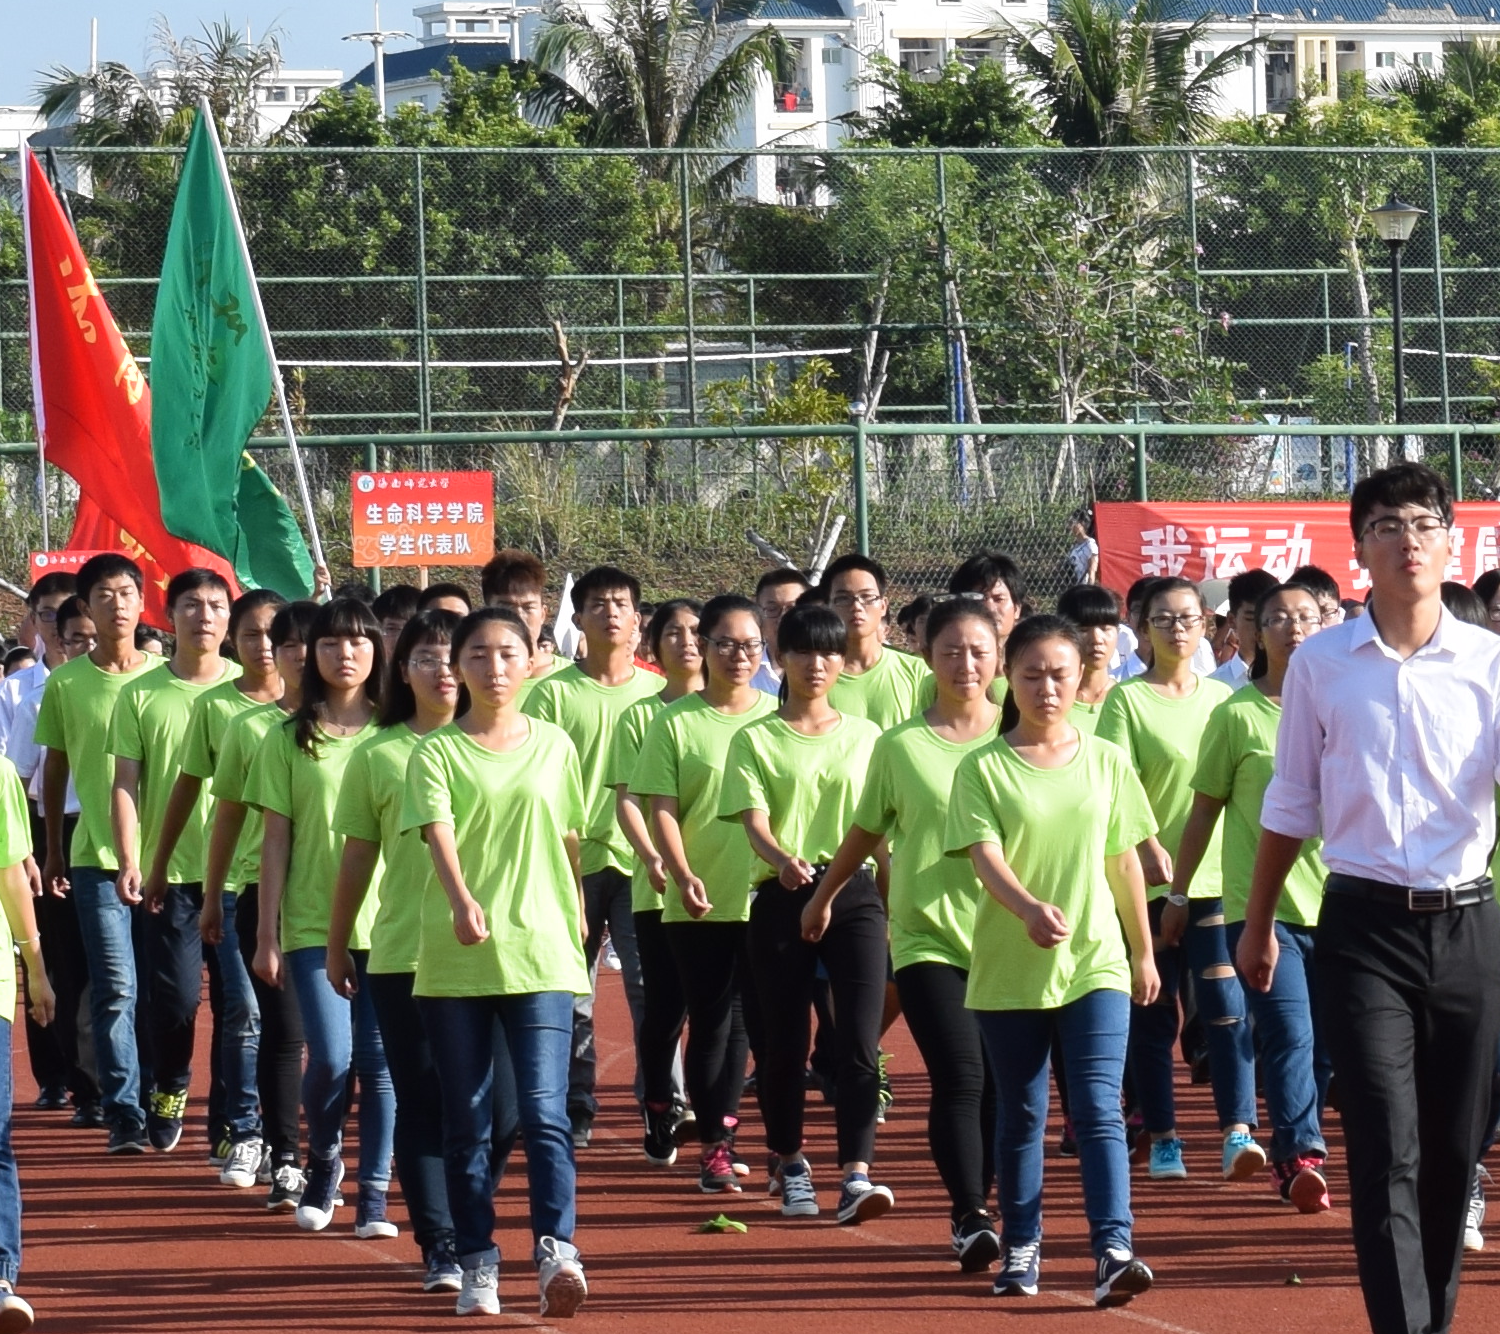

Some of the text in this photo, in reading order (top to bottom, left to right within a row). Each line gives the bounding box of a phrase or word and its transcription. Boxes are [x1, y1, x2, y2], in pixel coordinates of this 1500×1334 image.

[378, 477, 450, 490] 海南师范大学
[366, 502, 485, 525] 生命科学学院
[380, 533, 472, 556] 学生代表队
[1140, 523, 1312, 585] 我运动
